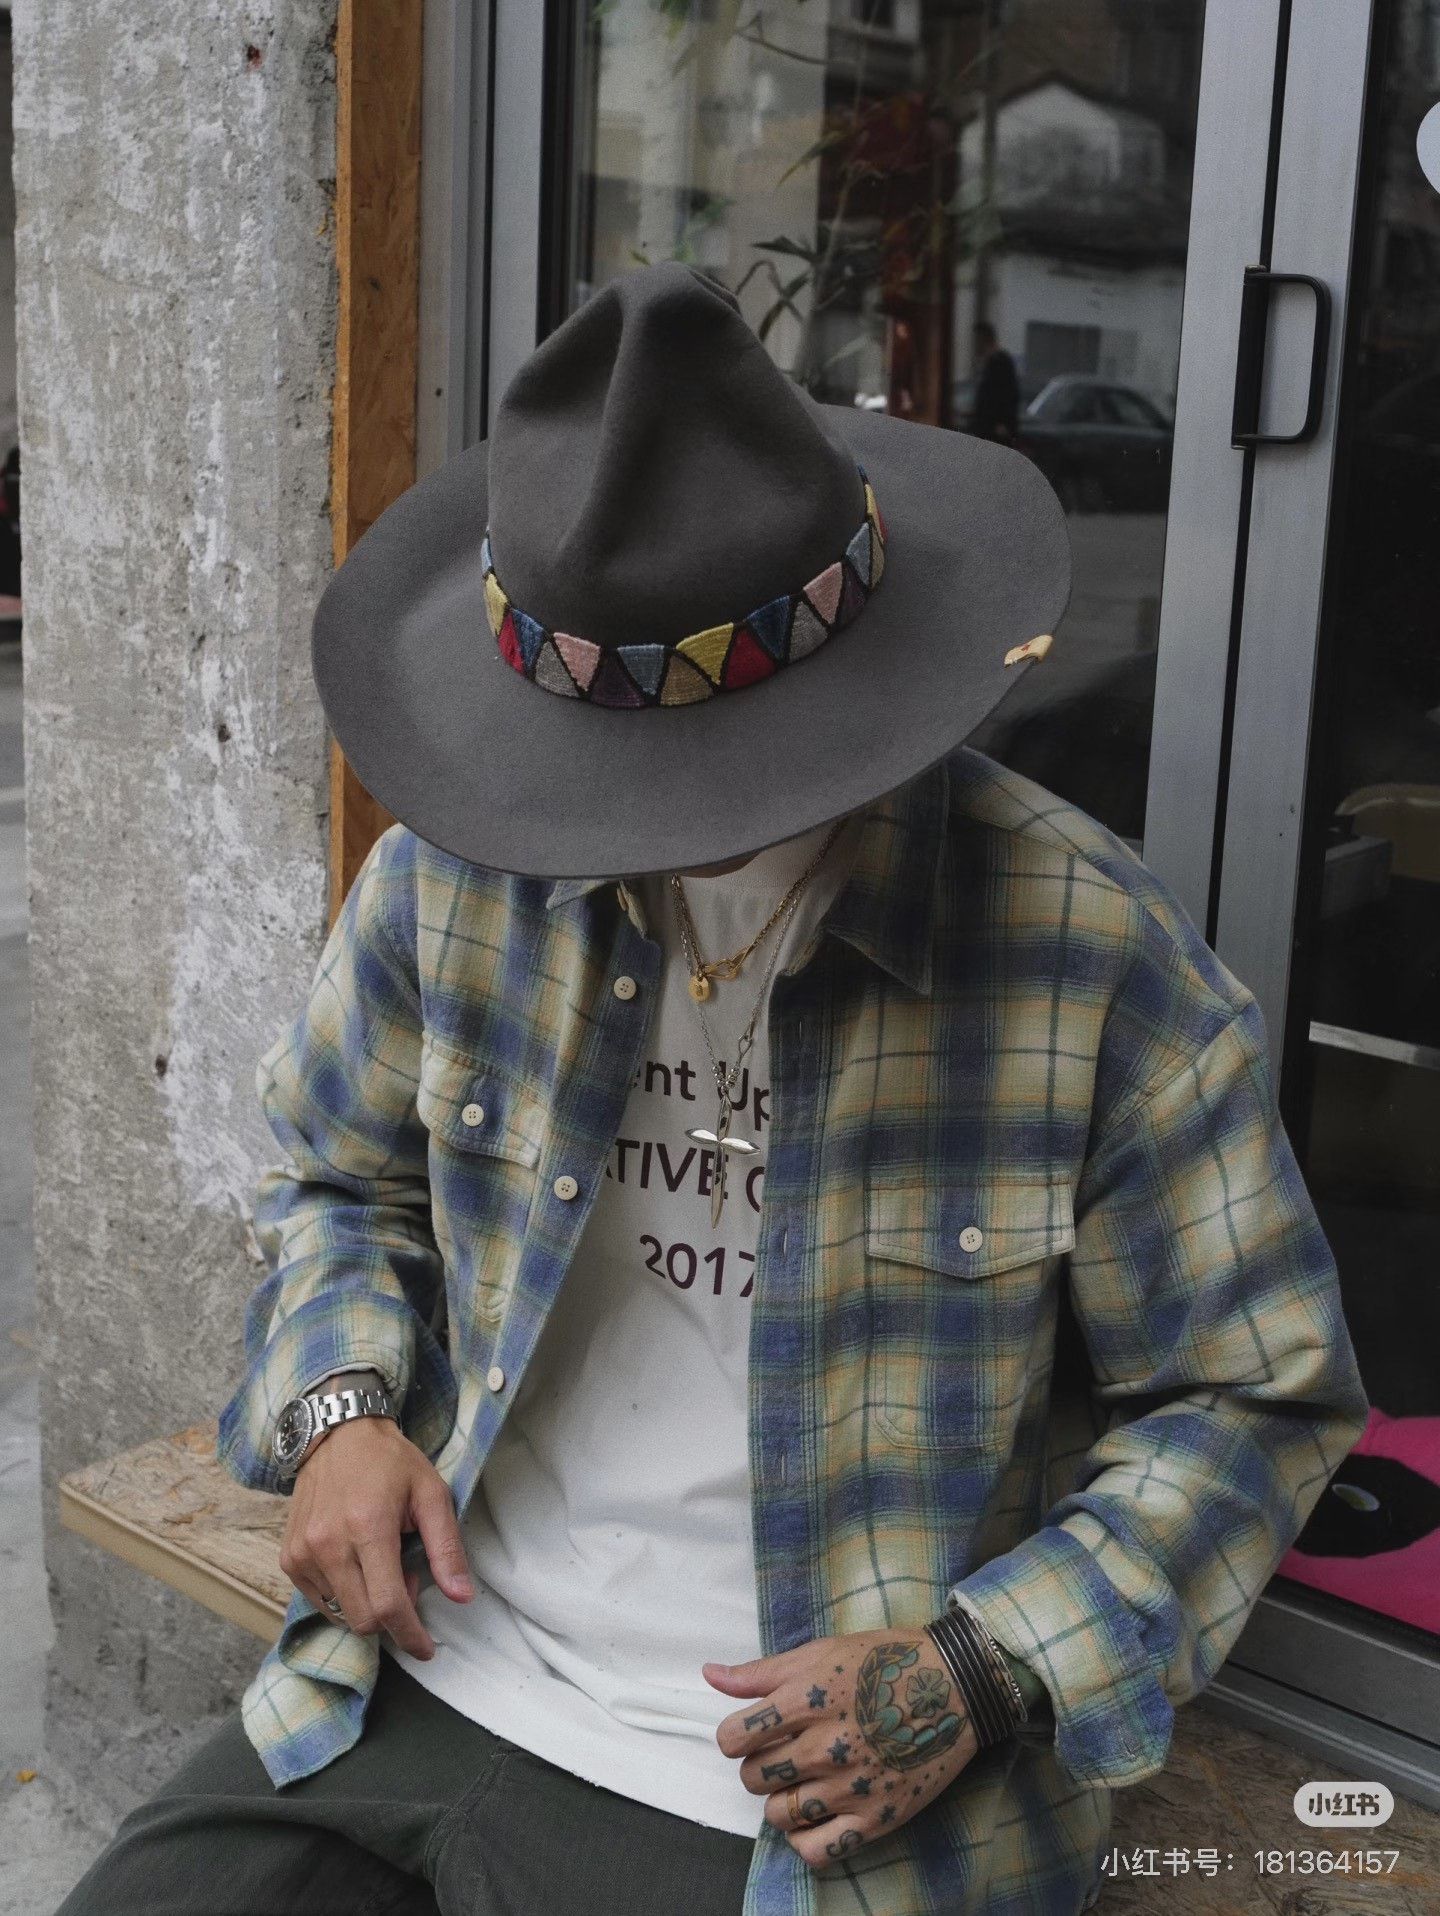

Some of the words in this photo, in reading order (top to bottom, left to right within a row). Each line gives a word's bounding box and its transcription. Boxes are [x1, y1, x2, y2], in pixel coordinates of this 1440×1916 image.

[634, 1060, 696, 1101] nt
[606, 1138, 729, 1200] TIVE
[639, 1234, 755, 1298] 2017
